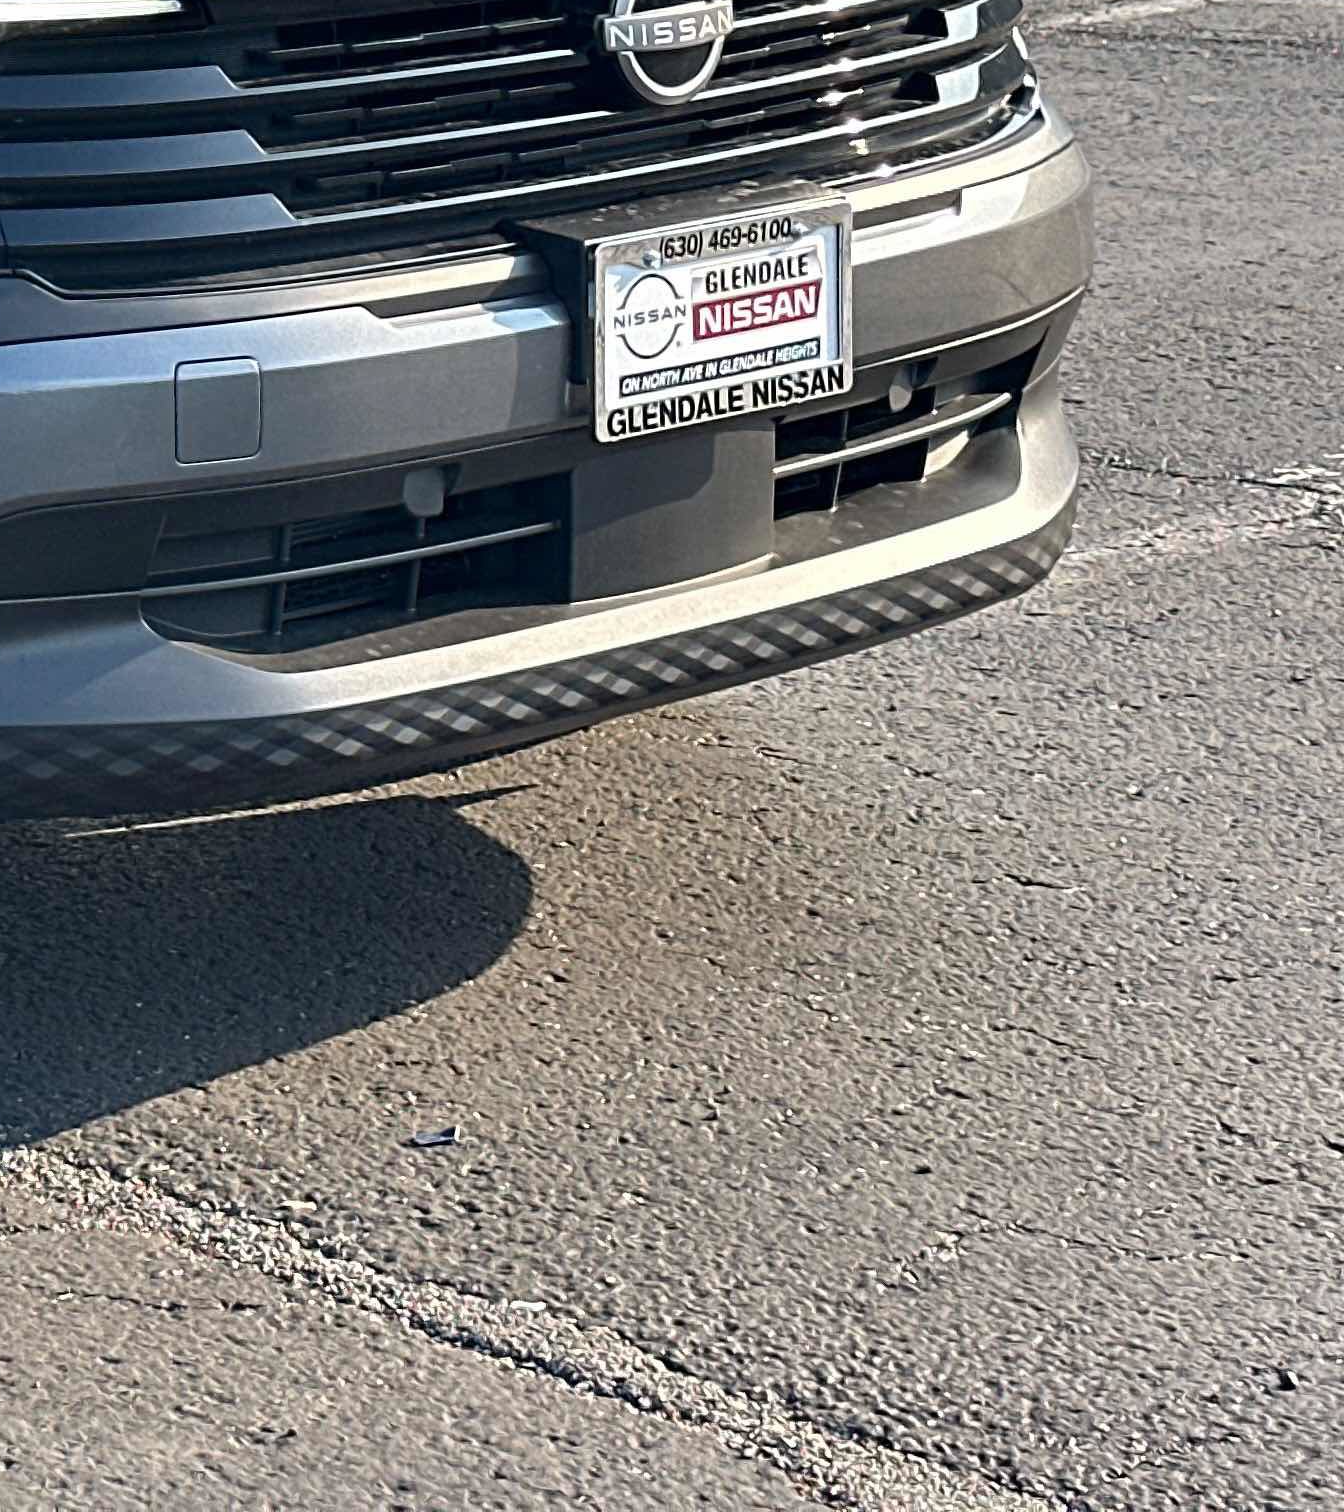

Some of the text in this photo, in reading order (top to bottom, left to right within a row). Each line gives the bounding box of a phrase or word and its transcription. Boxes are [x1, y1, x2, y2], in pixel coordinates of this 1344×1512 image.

[610, 5, 732, 48] NISSAN
[659, 217, 792, 260] (630) 469-6100
[705, 253, 809, 295] GLENDALE
[614, 304, 686, 329] NISSAN
[698, 285, 816, 336] NISSAN
[622, 340, 818, 394] ON NORTH AVE IN GLENDALE HEIGHTS
[607, 363, 844, 437] GLENDALE NISSAN
